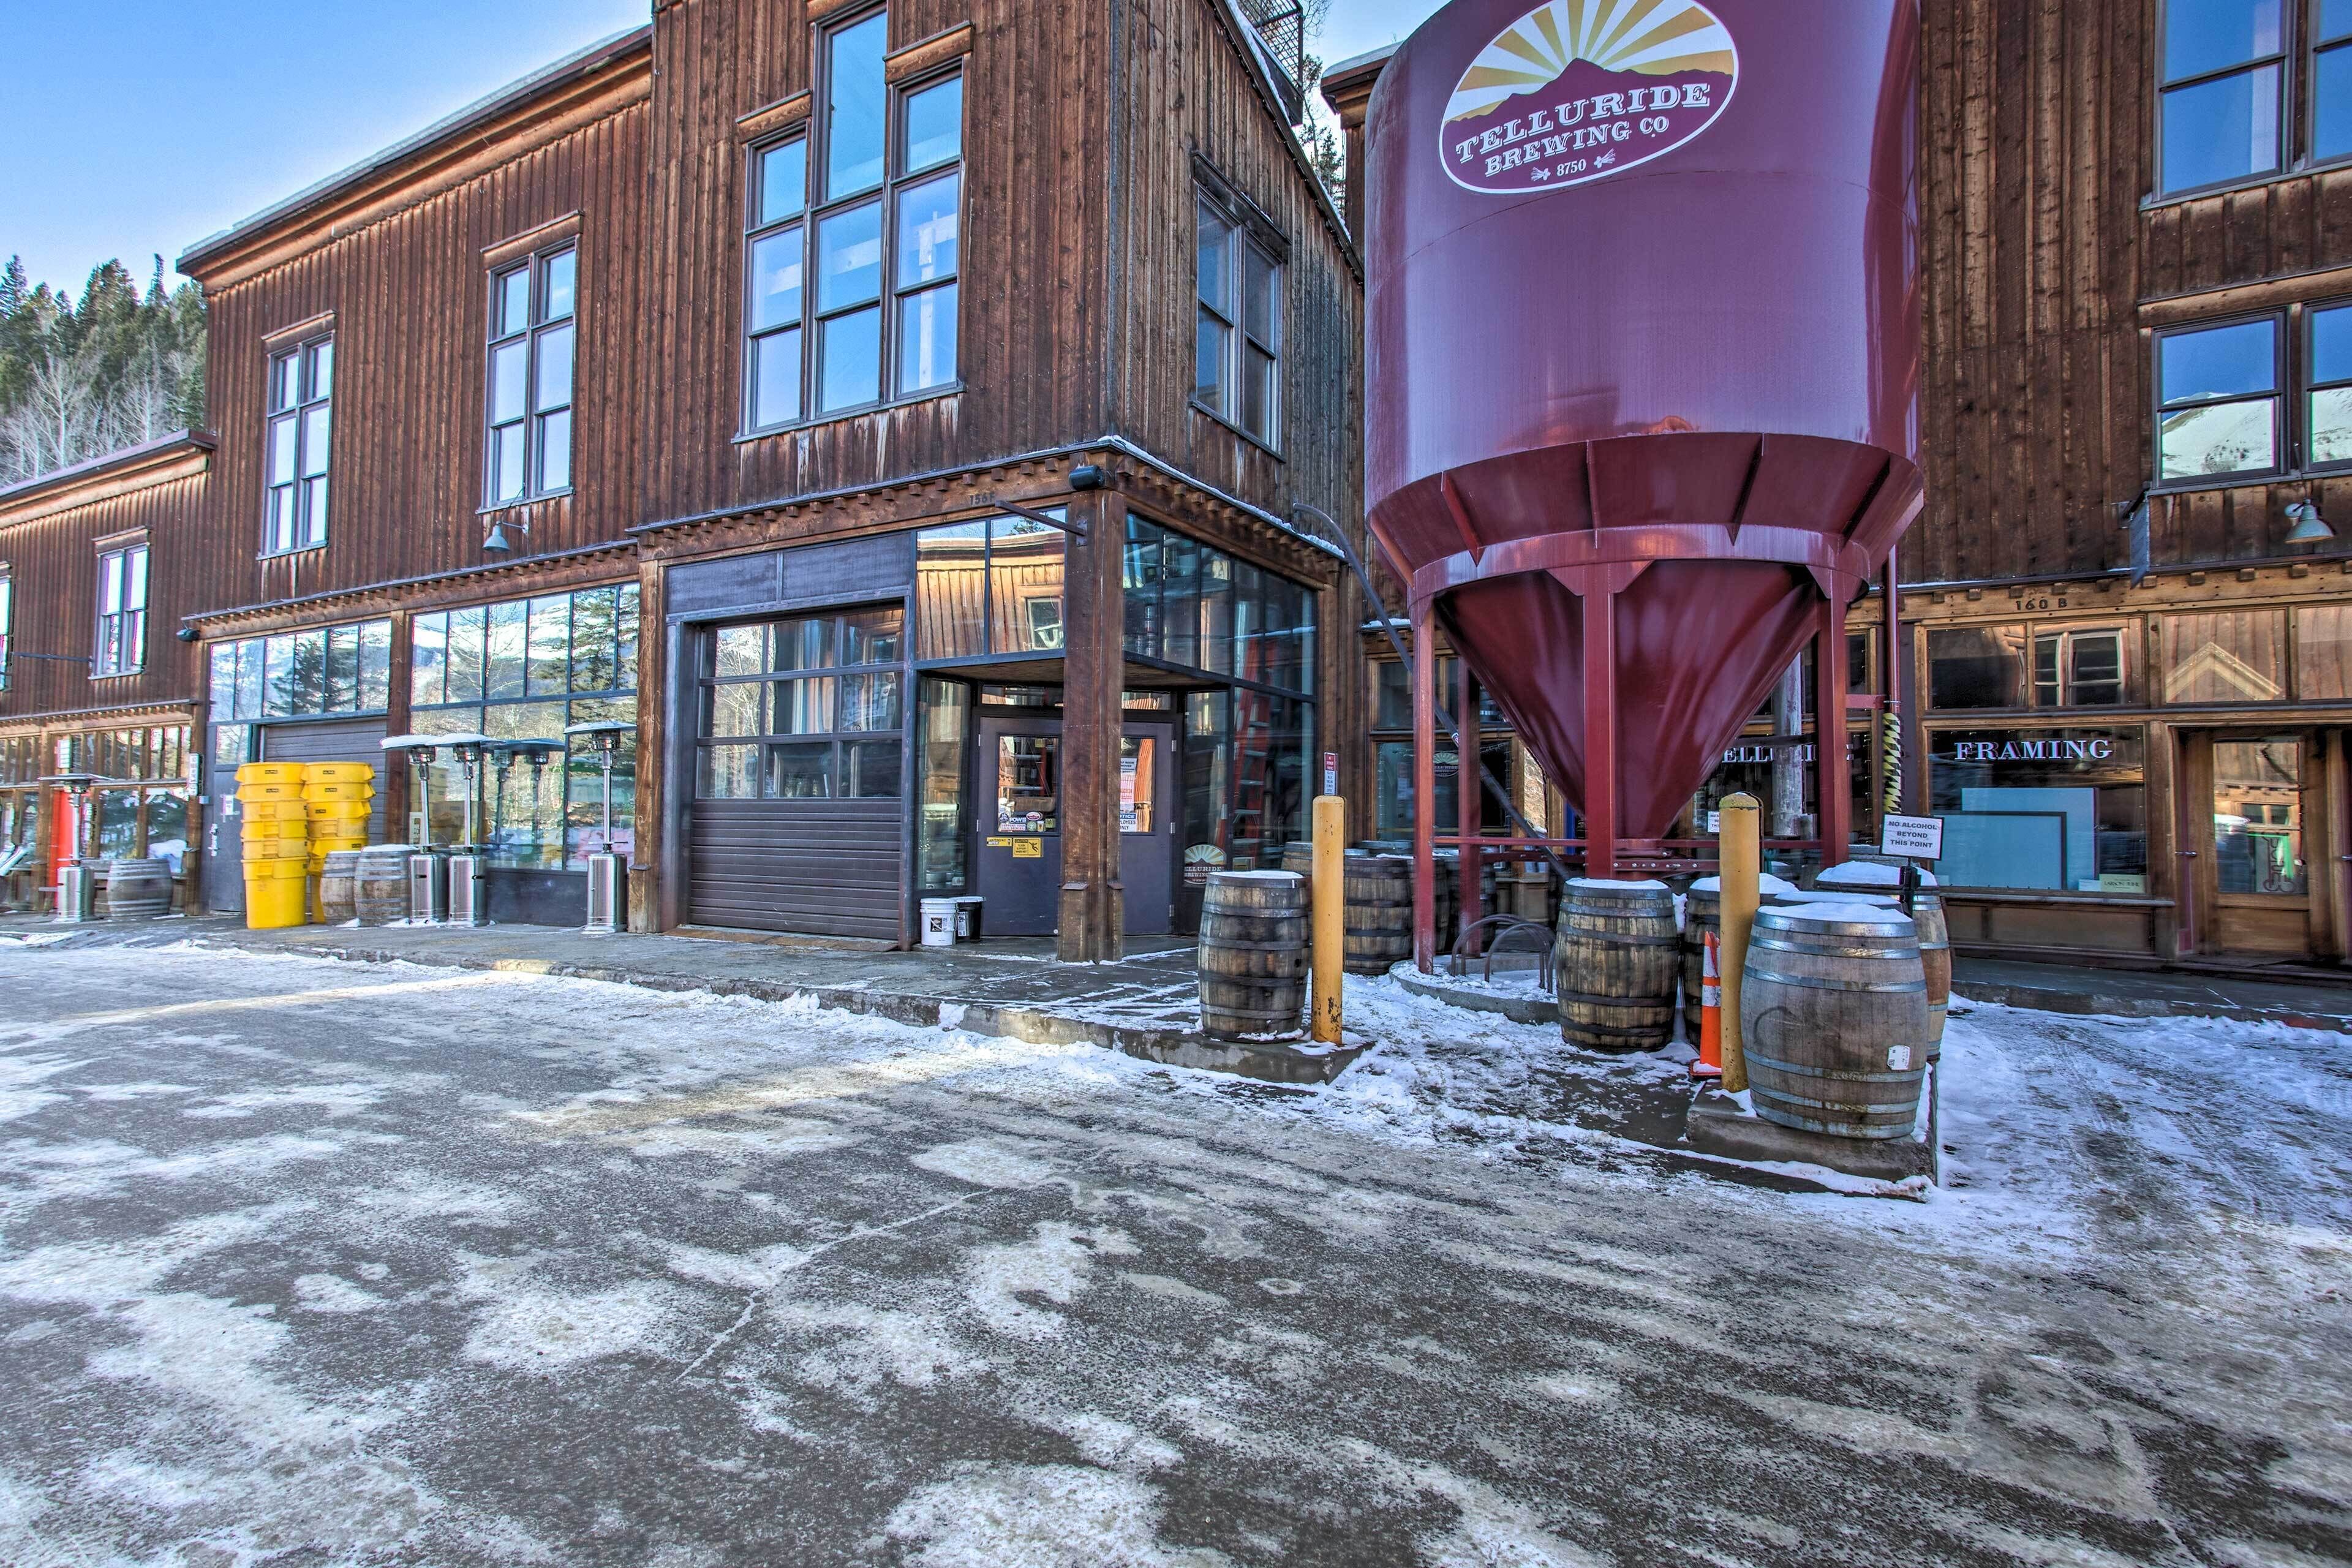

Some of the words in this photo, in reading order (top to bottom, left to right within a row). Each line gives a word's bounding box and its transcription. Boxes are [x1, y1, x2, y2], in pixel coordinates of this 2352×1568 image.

[1455, 83, 1710, 164] TELLURIDE
[1485, 121, 1632, 176] BREWING
[1556, 159, 1586, 176] 8750
[2016, 598, 2048, 611] 160
[1954, 740, 2113, 760] FRAMING
